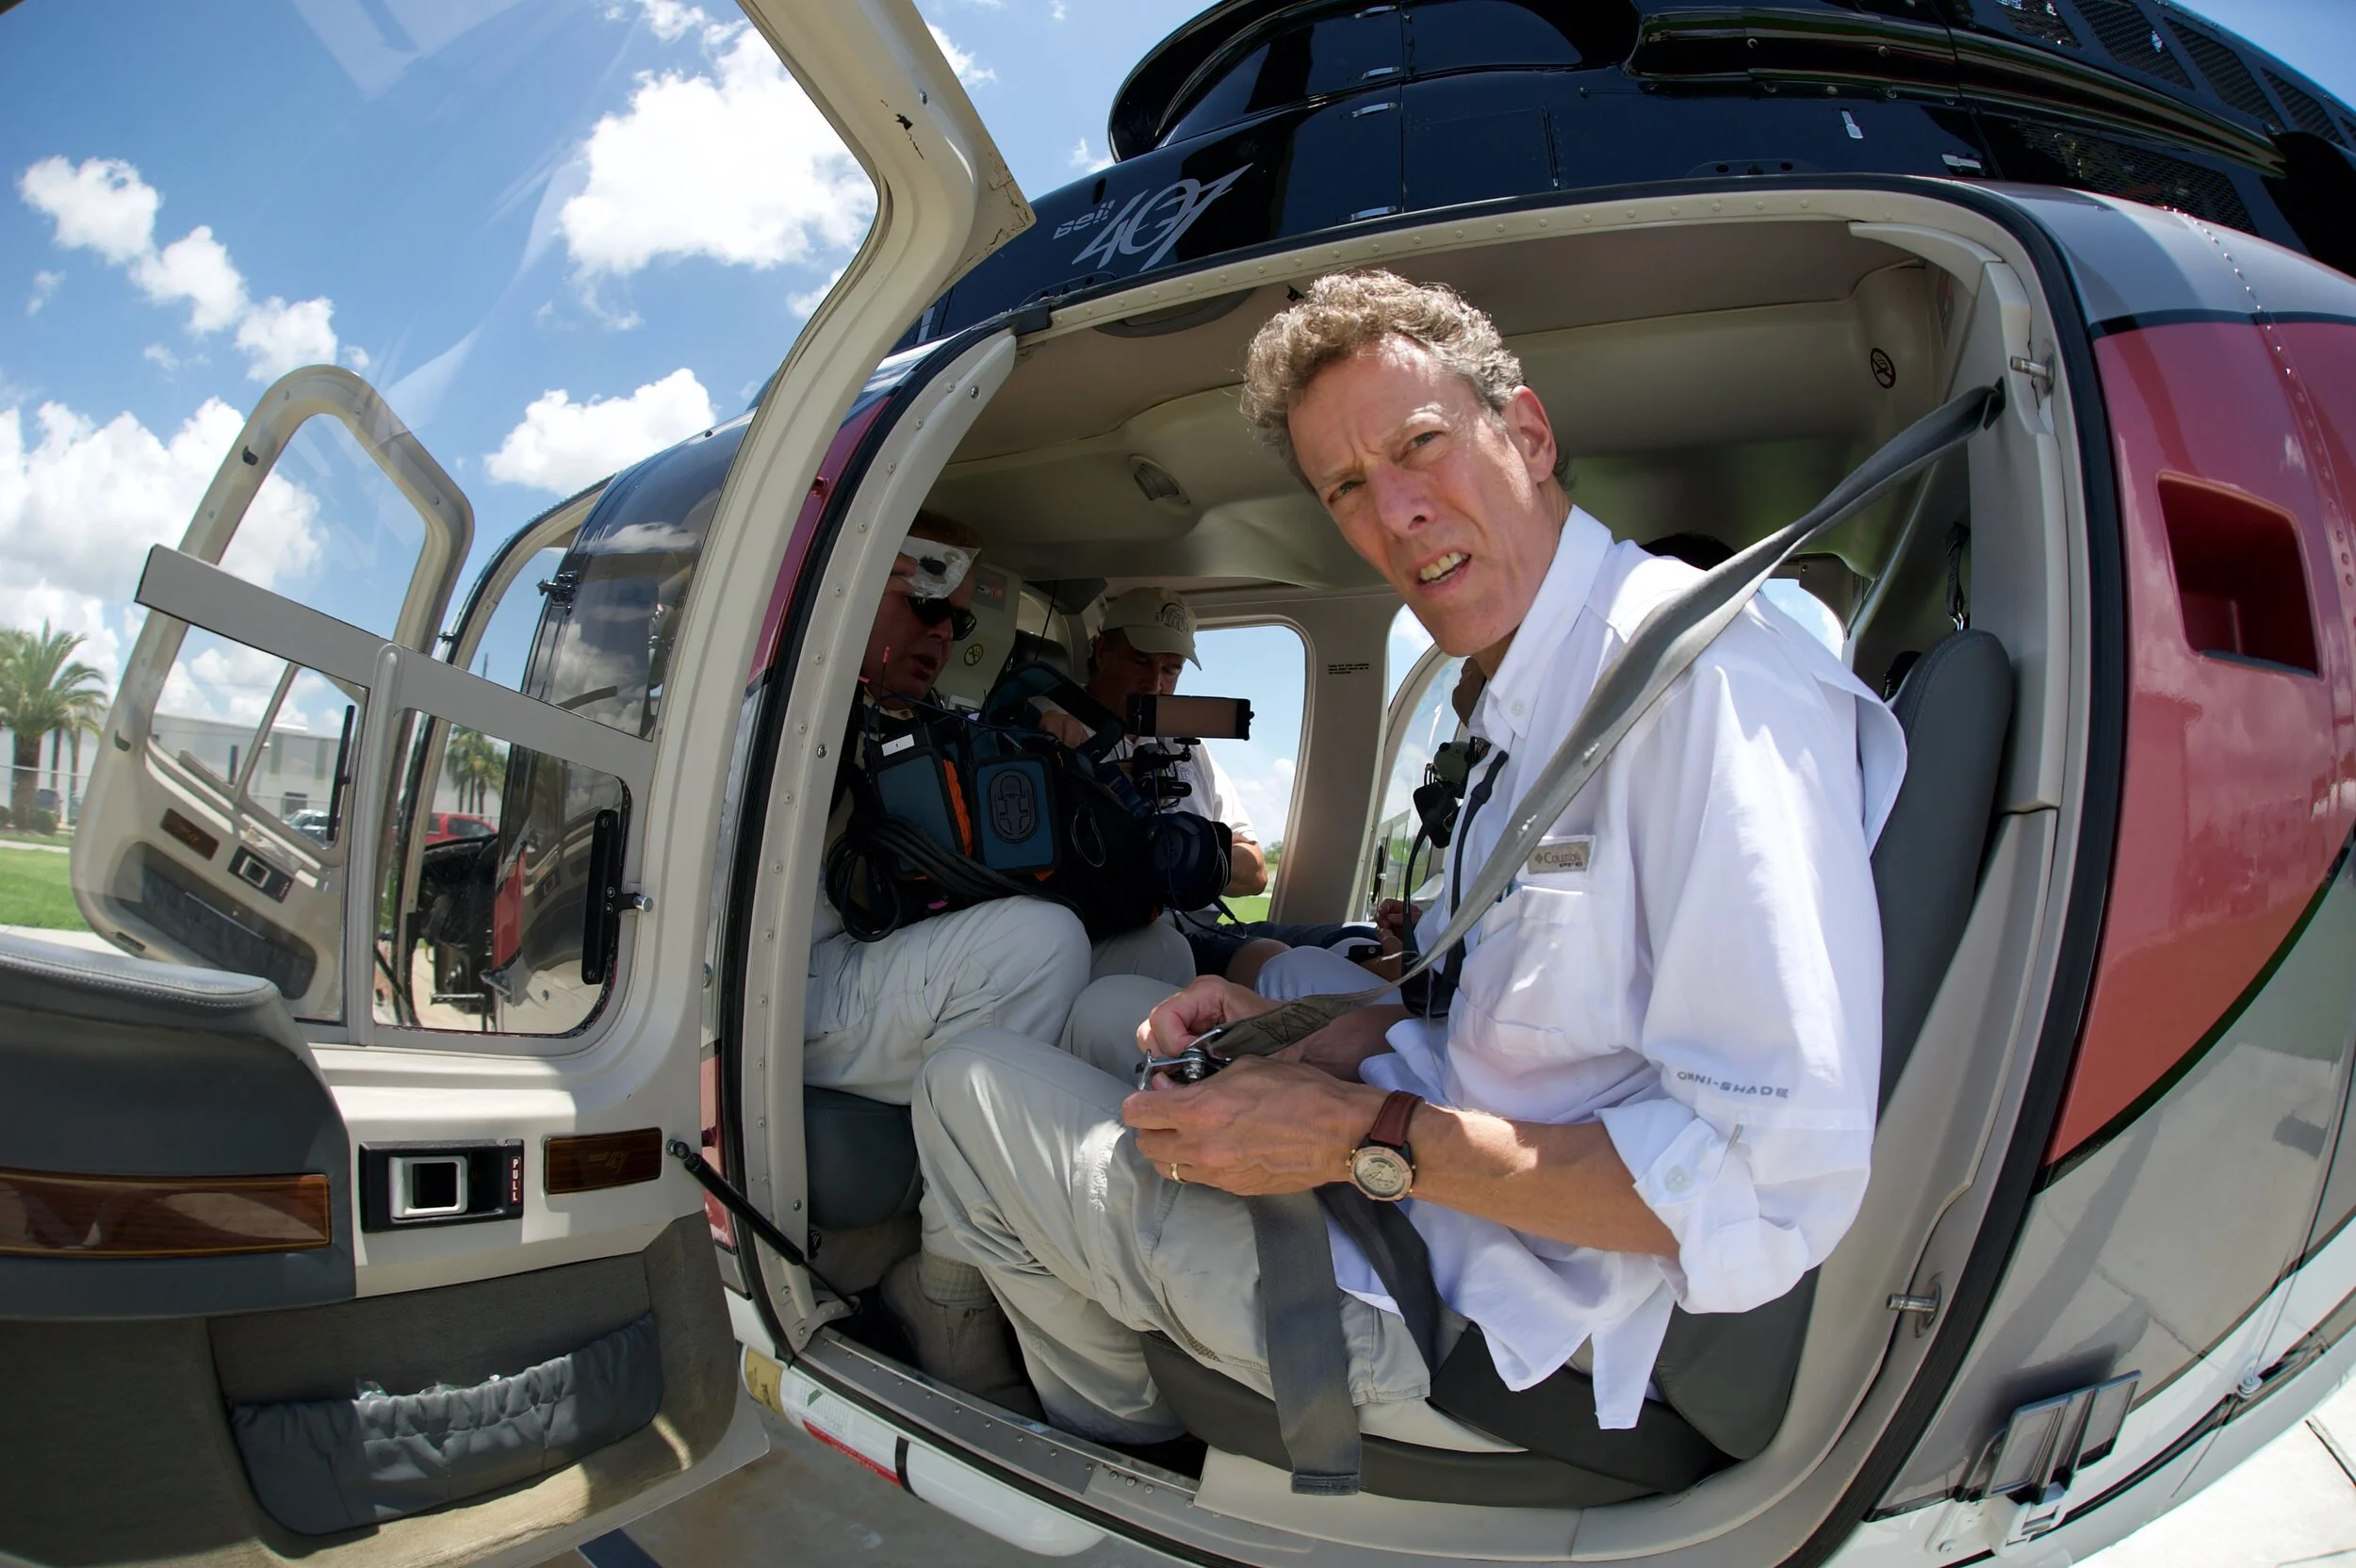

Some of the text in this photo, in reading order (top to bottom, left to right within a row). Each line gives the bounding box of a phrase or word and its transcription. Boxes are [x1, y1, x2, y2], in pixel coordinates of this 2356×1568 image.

[1054, 201, 1115, 239] Bell
[1071, 162, 1254, 272] 407
[1677, 1070, 1790, 1099] OMNI-SHADE
